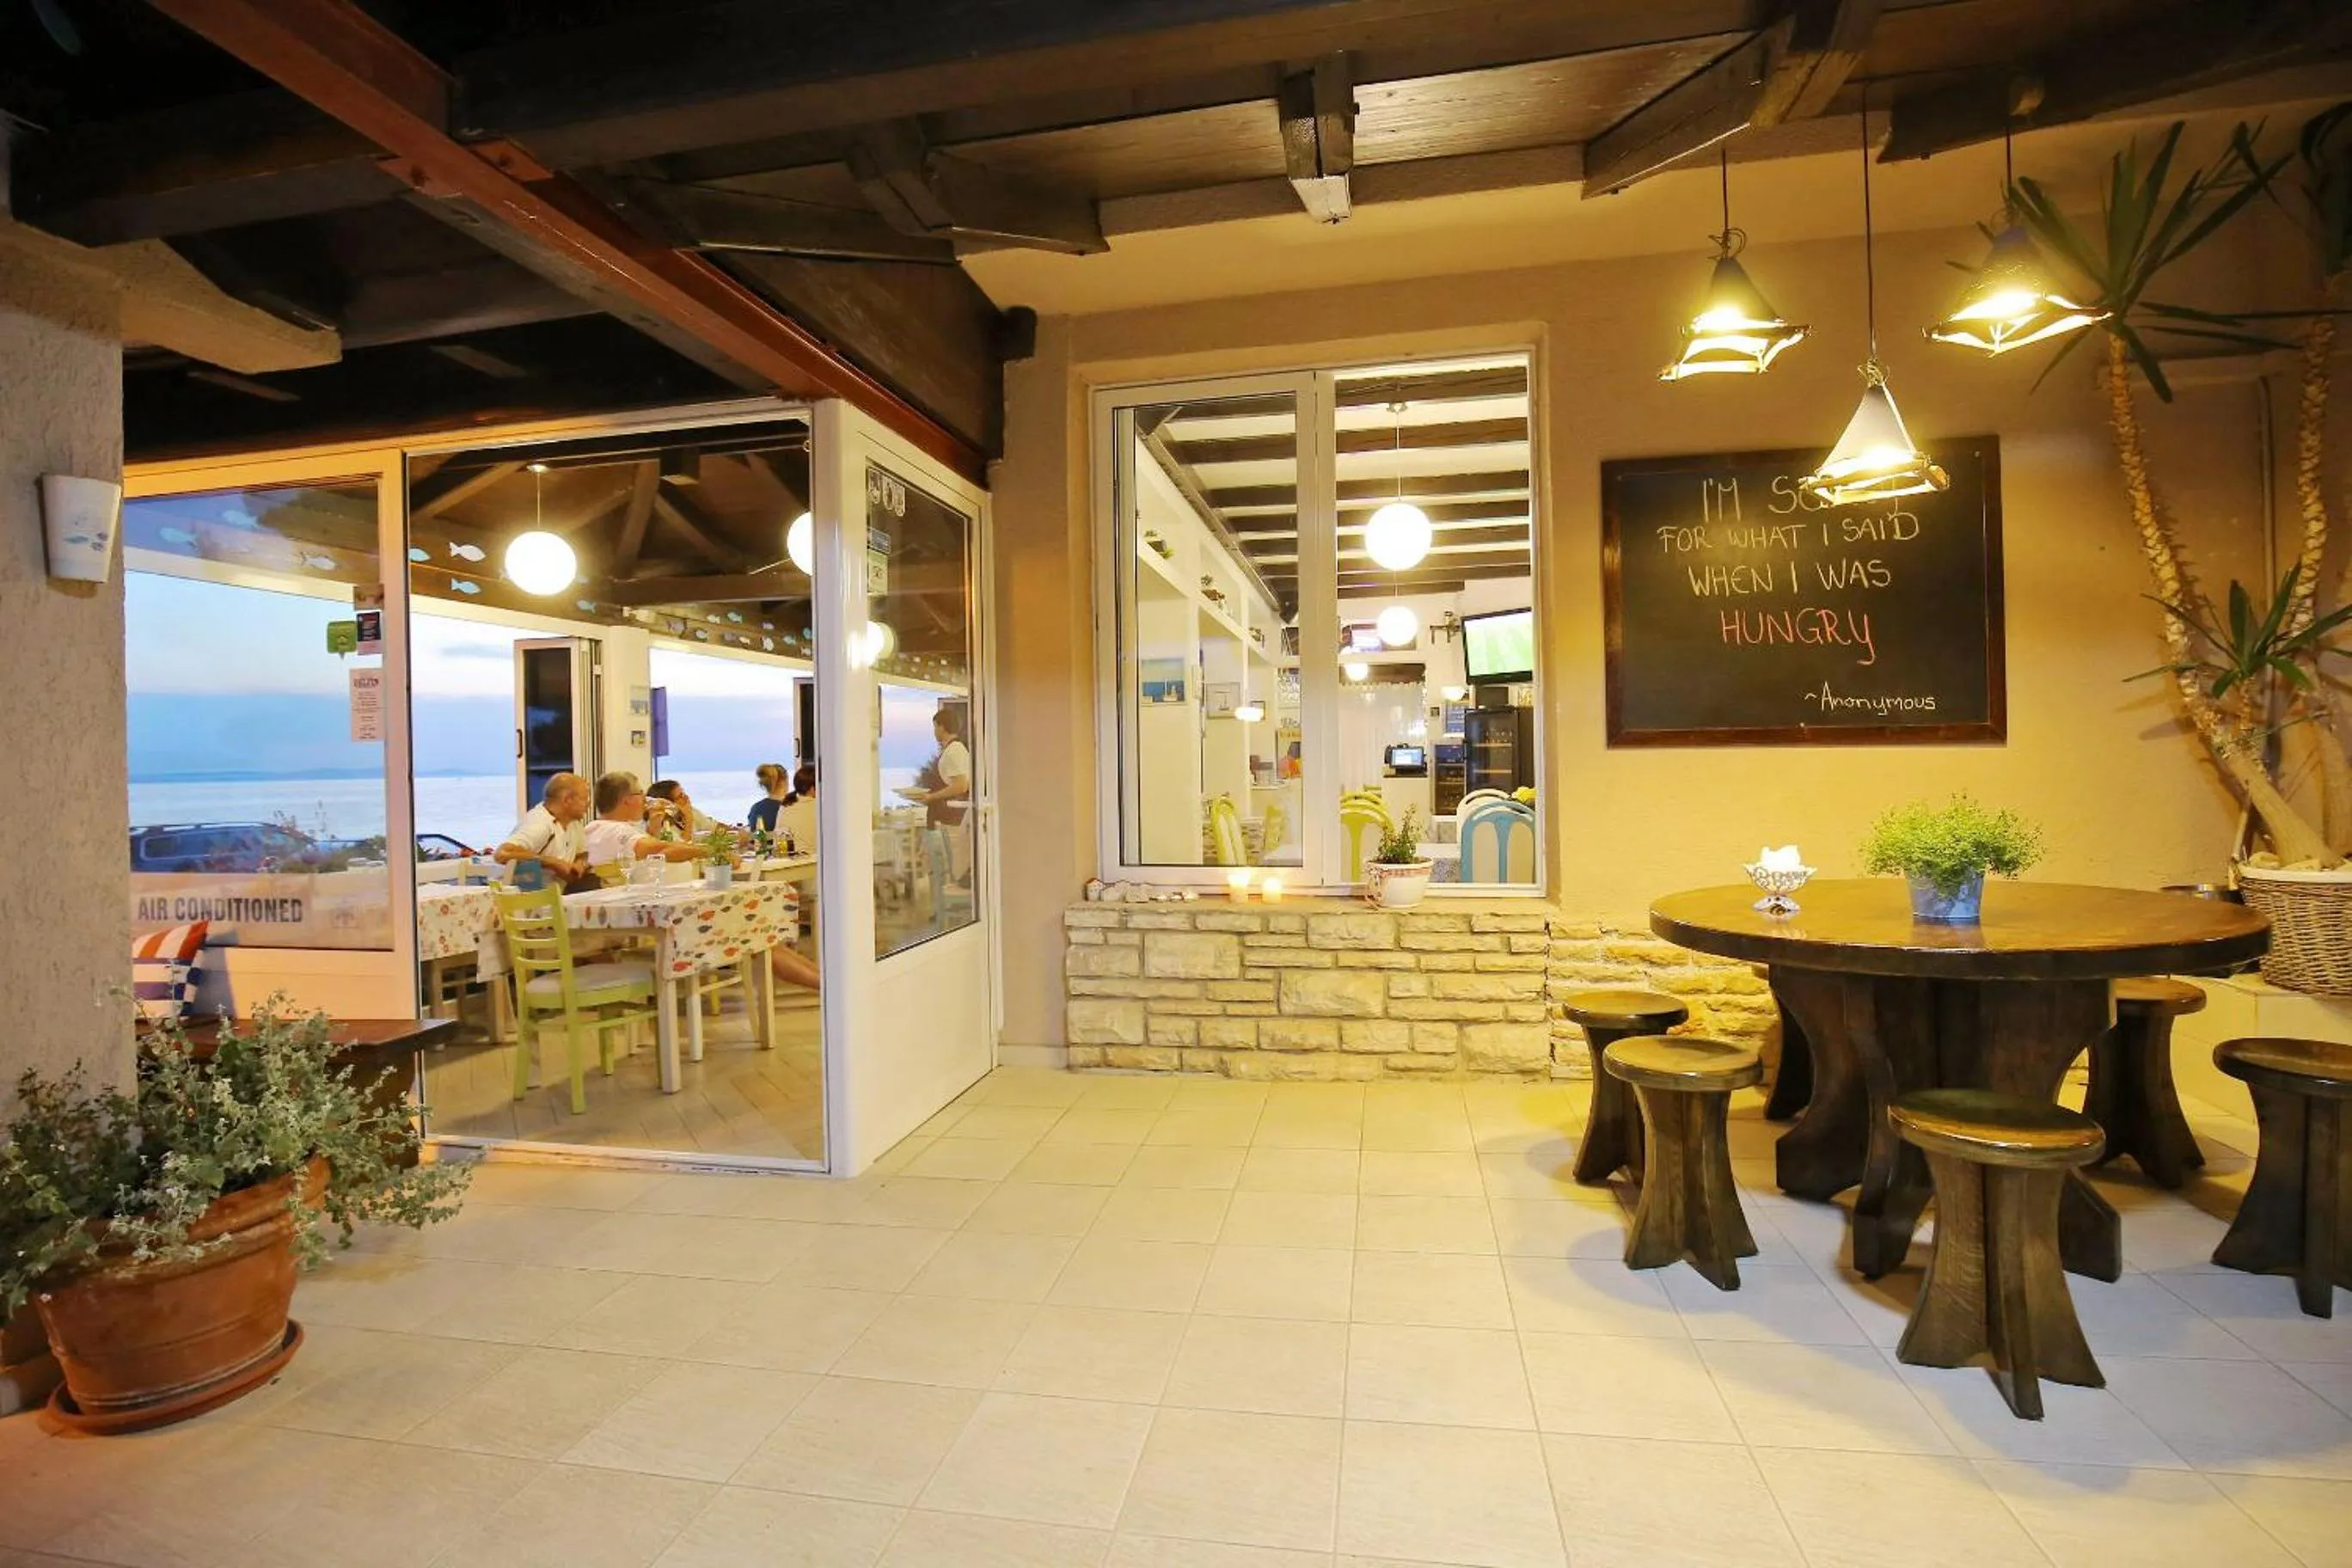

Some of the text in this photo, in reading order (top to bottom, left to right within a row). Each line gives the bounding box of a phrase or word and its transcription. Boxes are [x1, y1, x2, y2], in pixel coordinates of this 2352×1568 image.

[1703, 477, 1741, 524] I'M
[1657, 511, 1920, 553] FOR WHAT I SAID
[1687, 558, 1892, 597] WHEN I WAS
[1721, 607, 1876, 665] HUNGRY
[138, 897, 303, 923] AIR CONDITIONED
